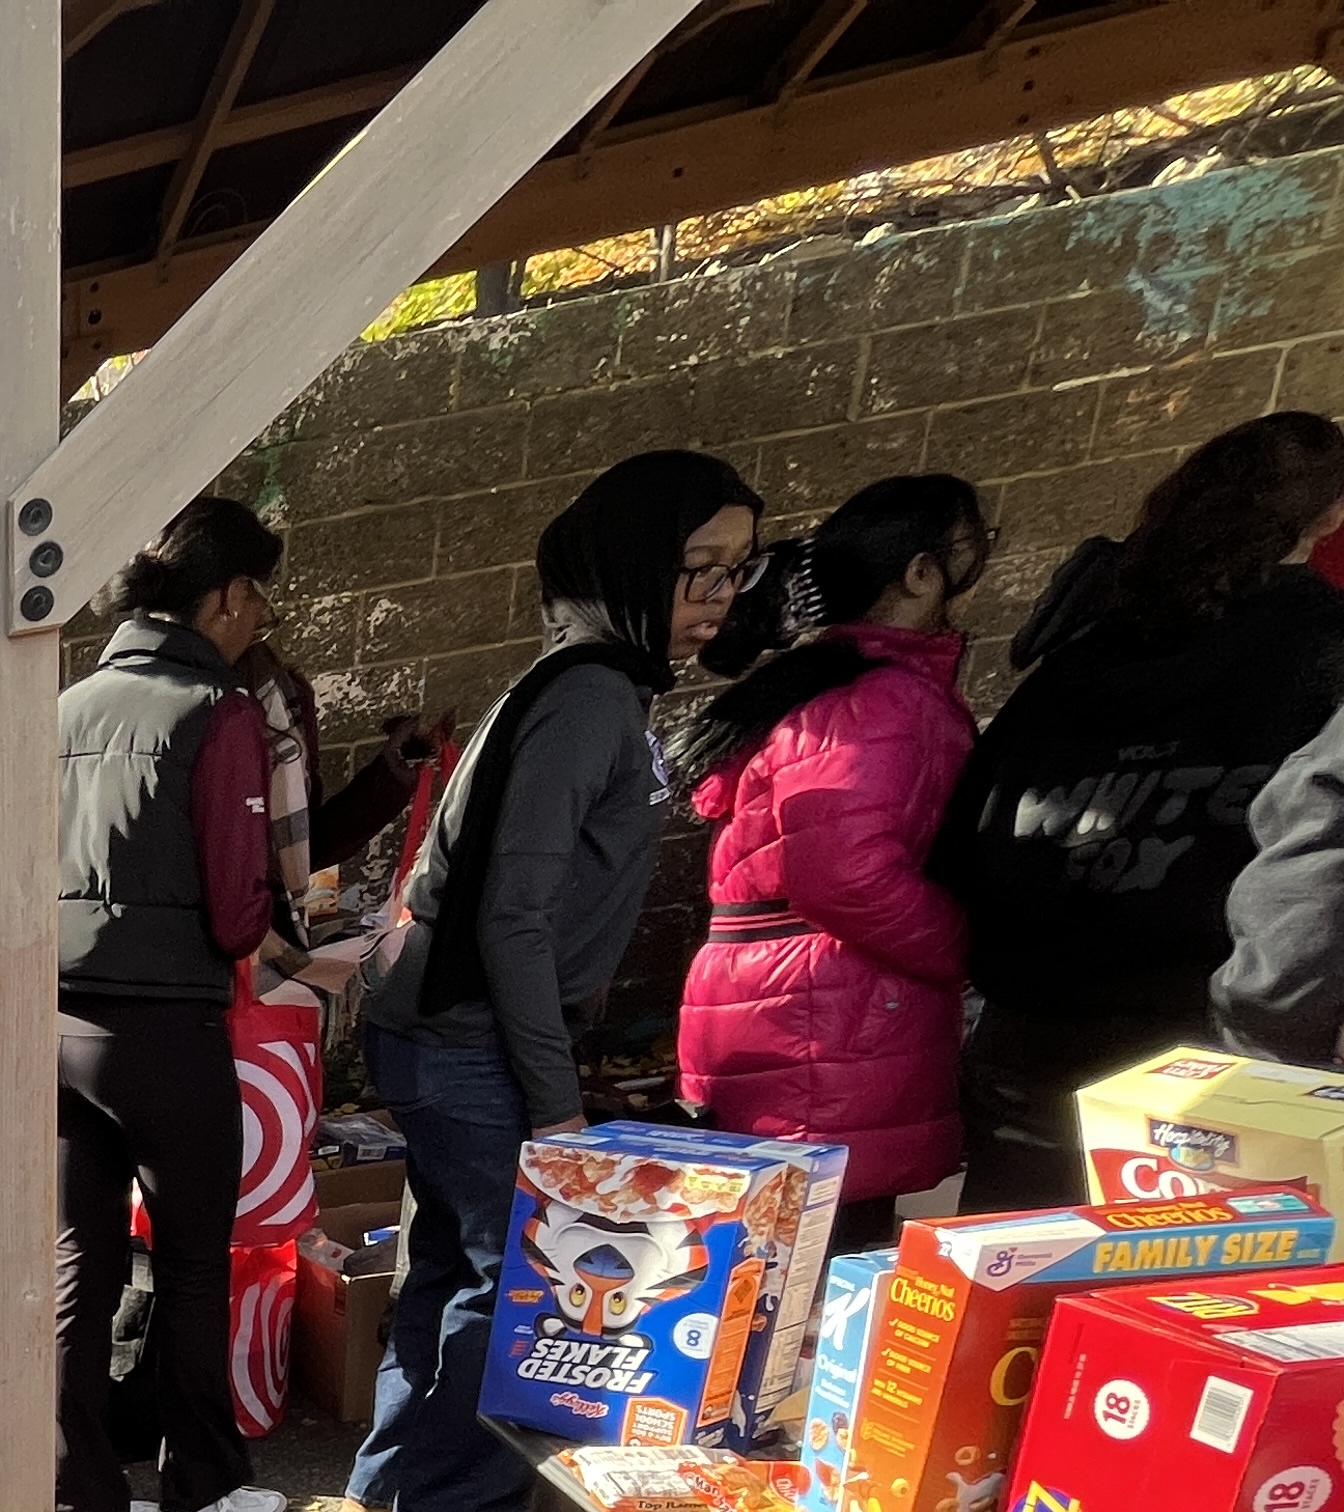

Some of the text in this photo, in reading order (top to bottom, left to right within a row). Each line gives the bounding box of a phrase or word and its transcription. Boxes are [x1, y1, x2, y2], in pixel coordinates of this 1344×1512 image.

[1107, 1207, 1234, 1229] Cheerios
[1093, 1229, 1298, 1274] FAMILY SIZE
[890, 1277, 956, 1322] Cheerios
[532, 1338, 649, 1370] FLAKES
[686, 1330, 700, 1347] 8
[517, 1357, 658, 1394] FROSTED
[1103, 1391, 1130, 1424] 18
